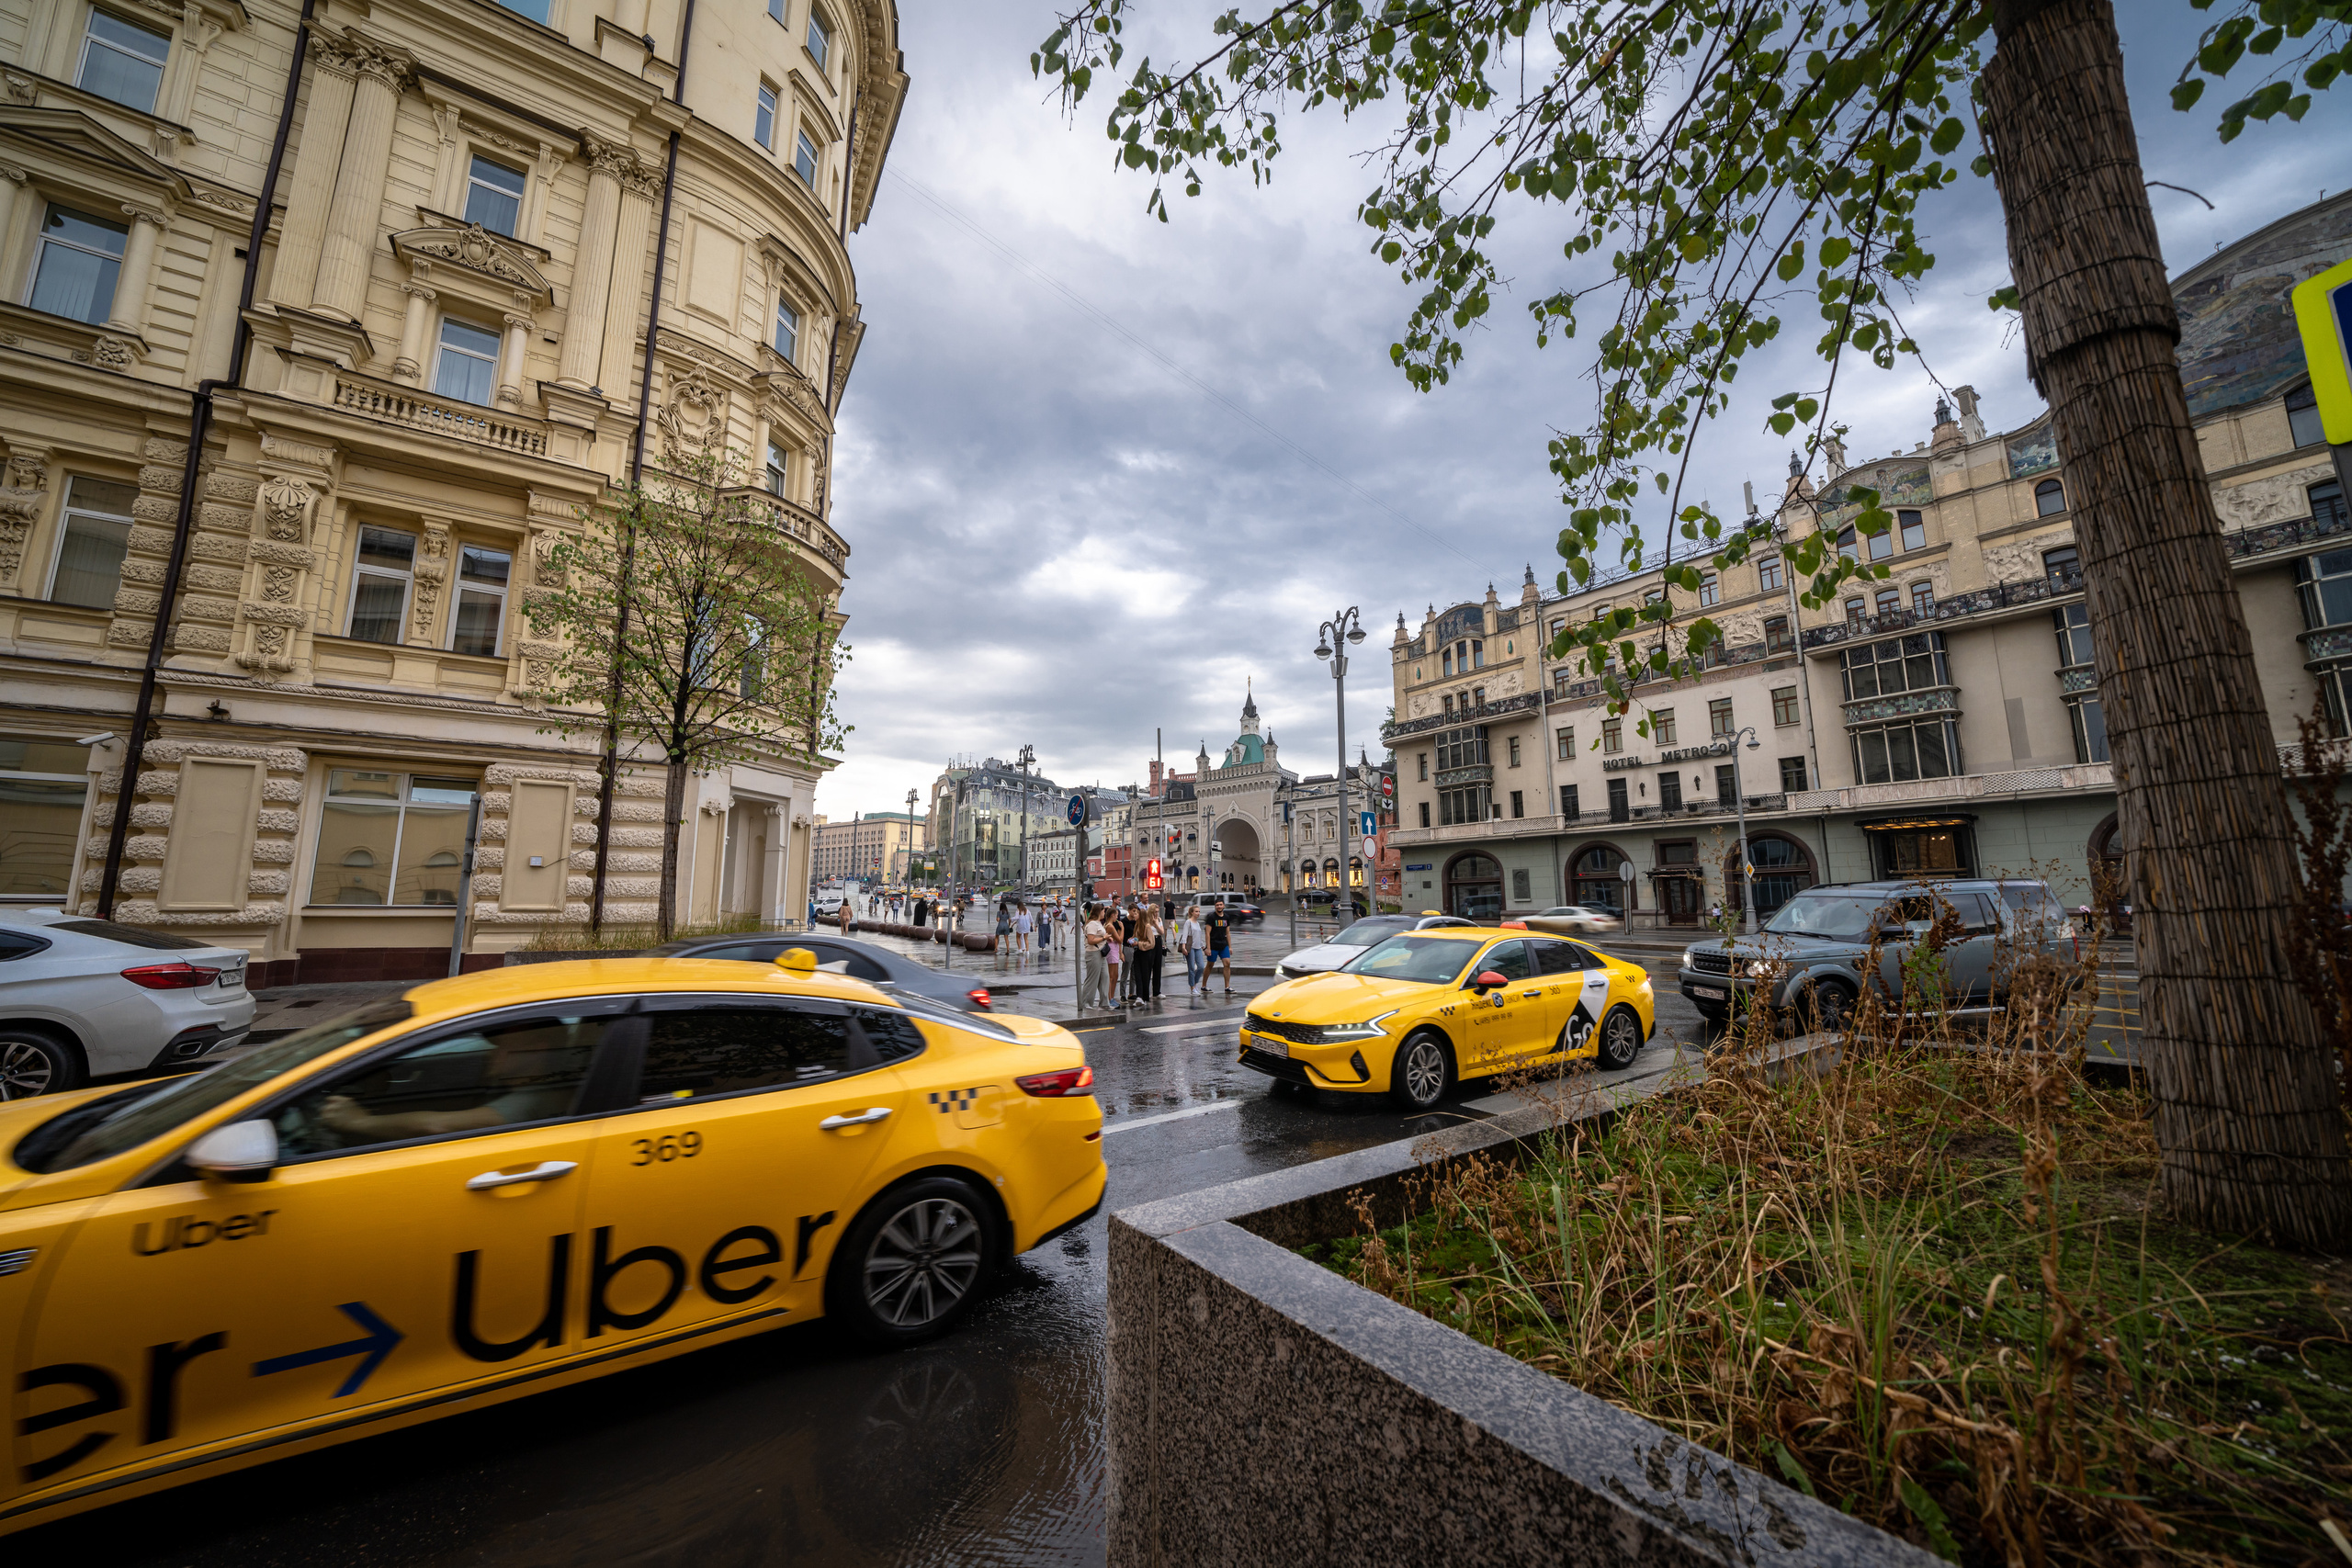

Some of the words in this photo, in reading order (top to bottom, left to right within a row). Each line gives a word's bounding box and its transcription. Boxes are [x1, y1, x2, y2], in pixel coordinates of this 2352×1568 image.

[1602, 756, 1642, 770] HOTEL
[1661, 743, 1732, 761] METROO
[1148, 876, 1160, 887] 61
[1694, 948, 1745, 956] DISCOVY
[1548, 984, 1560, 995] 563
[1470, 998, 1493, 1010] Яндекс
[1493, 994, 1503, 1007] Go
[630, 1131, 703, 1167] 369
[131, 1209, 279, 1256] Uber
[447, 1210, 838, 1361] Uber
